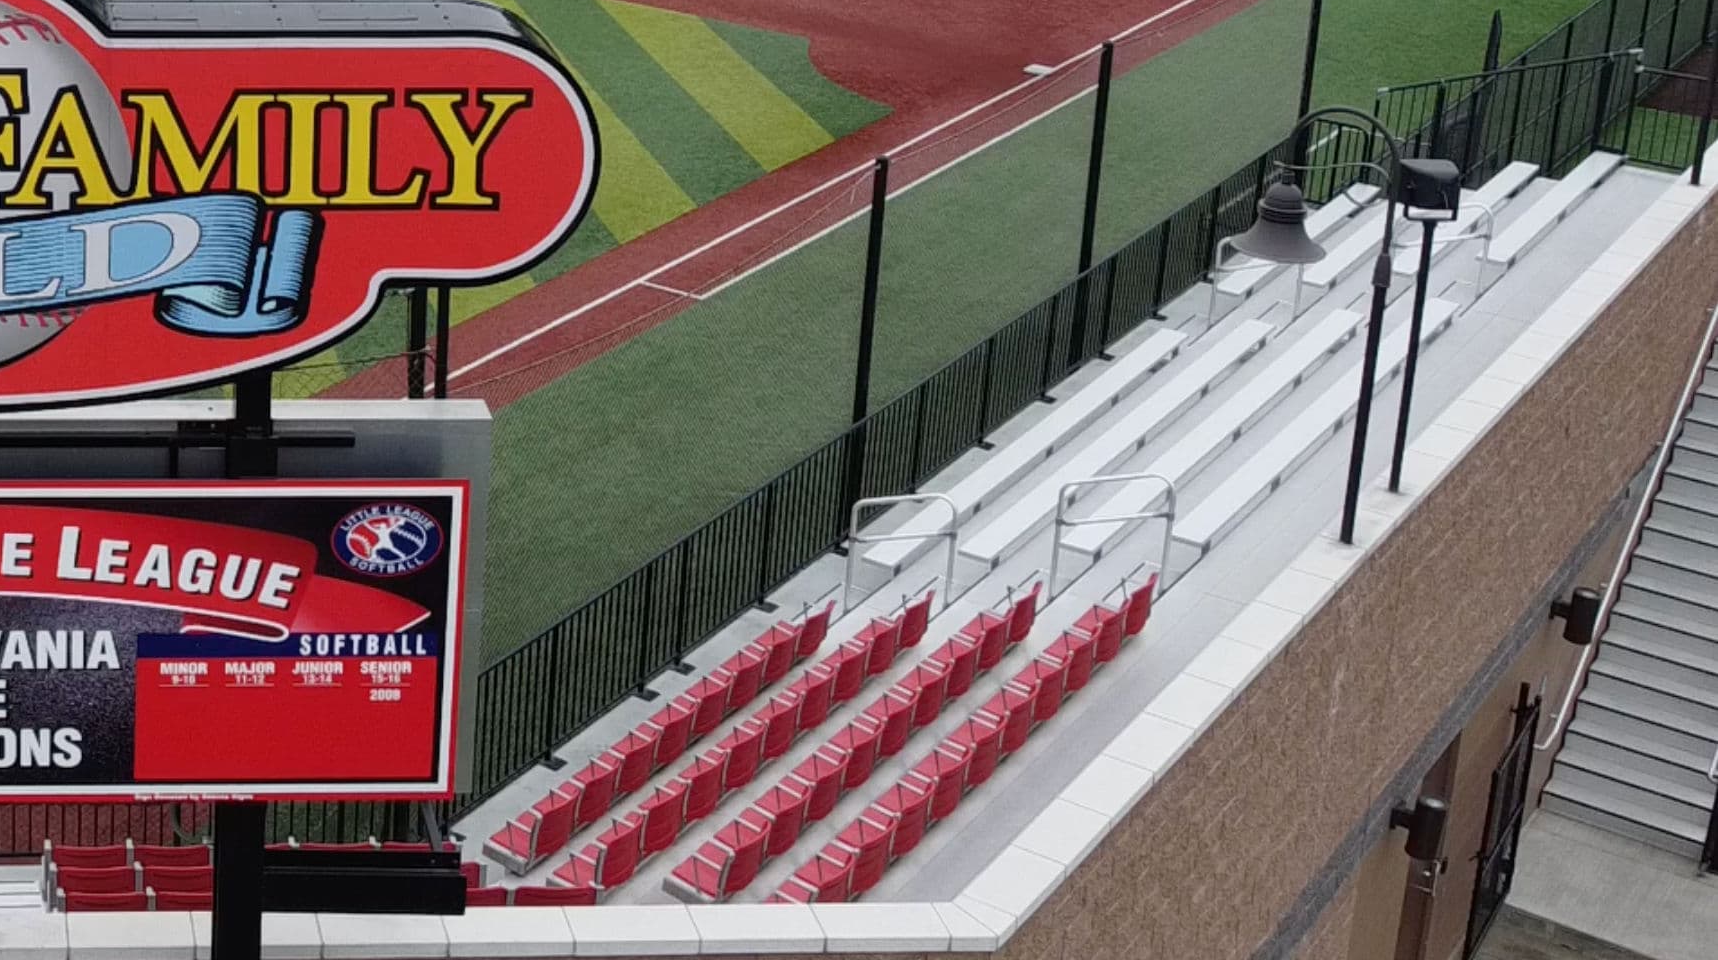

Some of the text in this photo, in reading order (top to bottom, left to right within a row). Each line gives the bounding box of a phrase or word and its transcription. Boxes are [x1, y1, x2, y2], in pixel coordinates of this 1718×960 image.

[340, 505, 435, 531] LITTLE LEAGUE
[56, 525, 301, 610] LEAGUE
[349, 556, 424, 574] SOFTBALL
[298, 634, 427, 656] SOFTBALL
[159, 662, 208, 675] MINOR
[224, 661, 276, 674] MAJOR
[292, 661, 344, 674] JUNIOR
[360, 661, 412, 674] SENIOR
